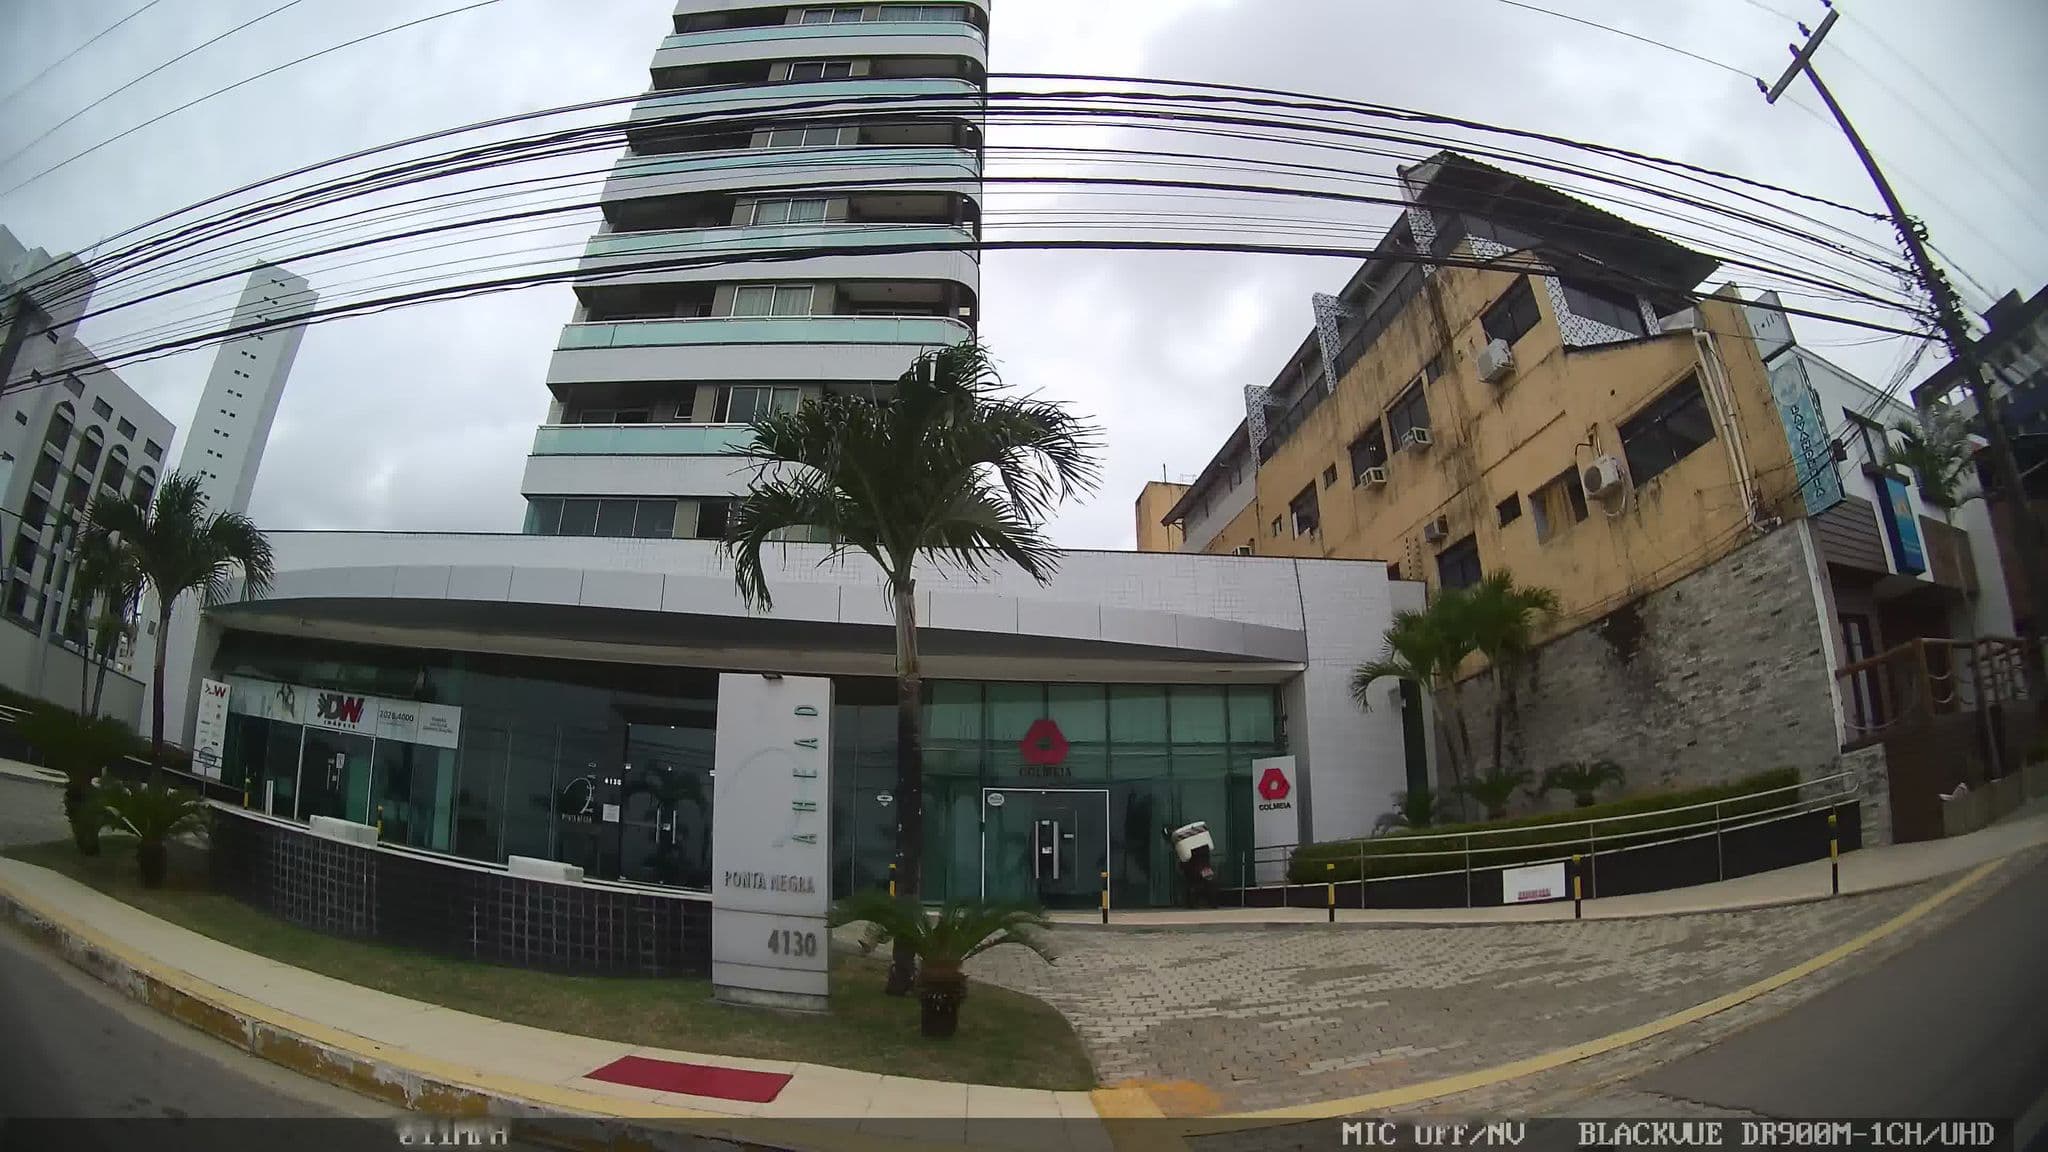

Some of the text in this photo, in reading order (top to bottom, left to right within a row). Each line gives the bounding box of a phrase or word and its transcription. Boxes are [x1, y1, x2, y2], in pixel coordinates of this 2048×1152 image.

[1258, 802, 1292, 811] COLMEIA
[724, 870, 816, 894] PONTA NEGRA
[767, 929, 818, 957] 4130
